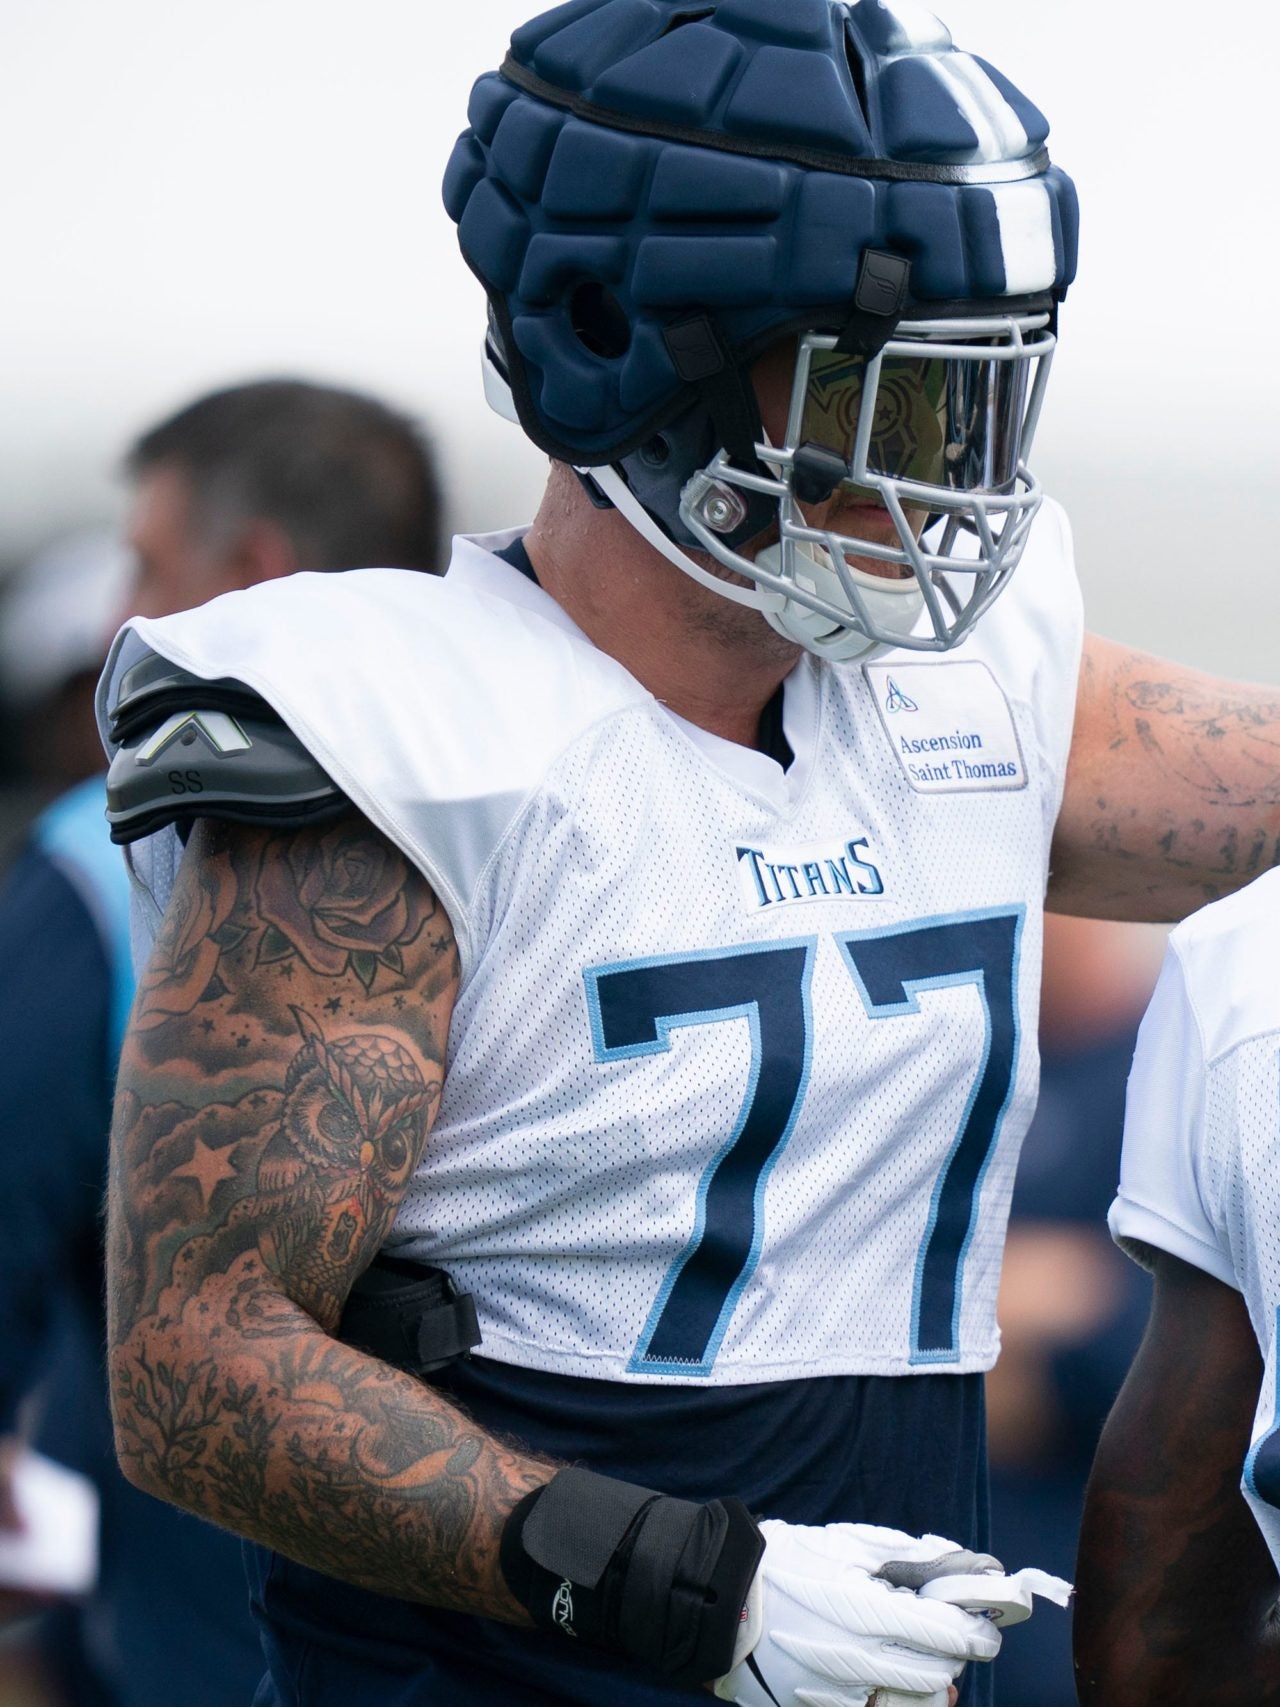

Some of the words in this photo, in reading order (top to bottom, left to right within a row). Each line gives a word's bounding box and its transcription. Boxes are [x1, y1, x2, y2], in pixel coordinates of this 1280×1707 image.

[900, 729, 983, 754] Ascension
[167, 770, 204, 795] SS
[908, 762, 952, 781] Saint
[951, 759, 1017, 780] Thomas
[735, 836, 885, 907] TITANS
[582, 902, 1028, 1378] 77
